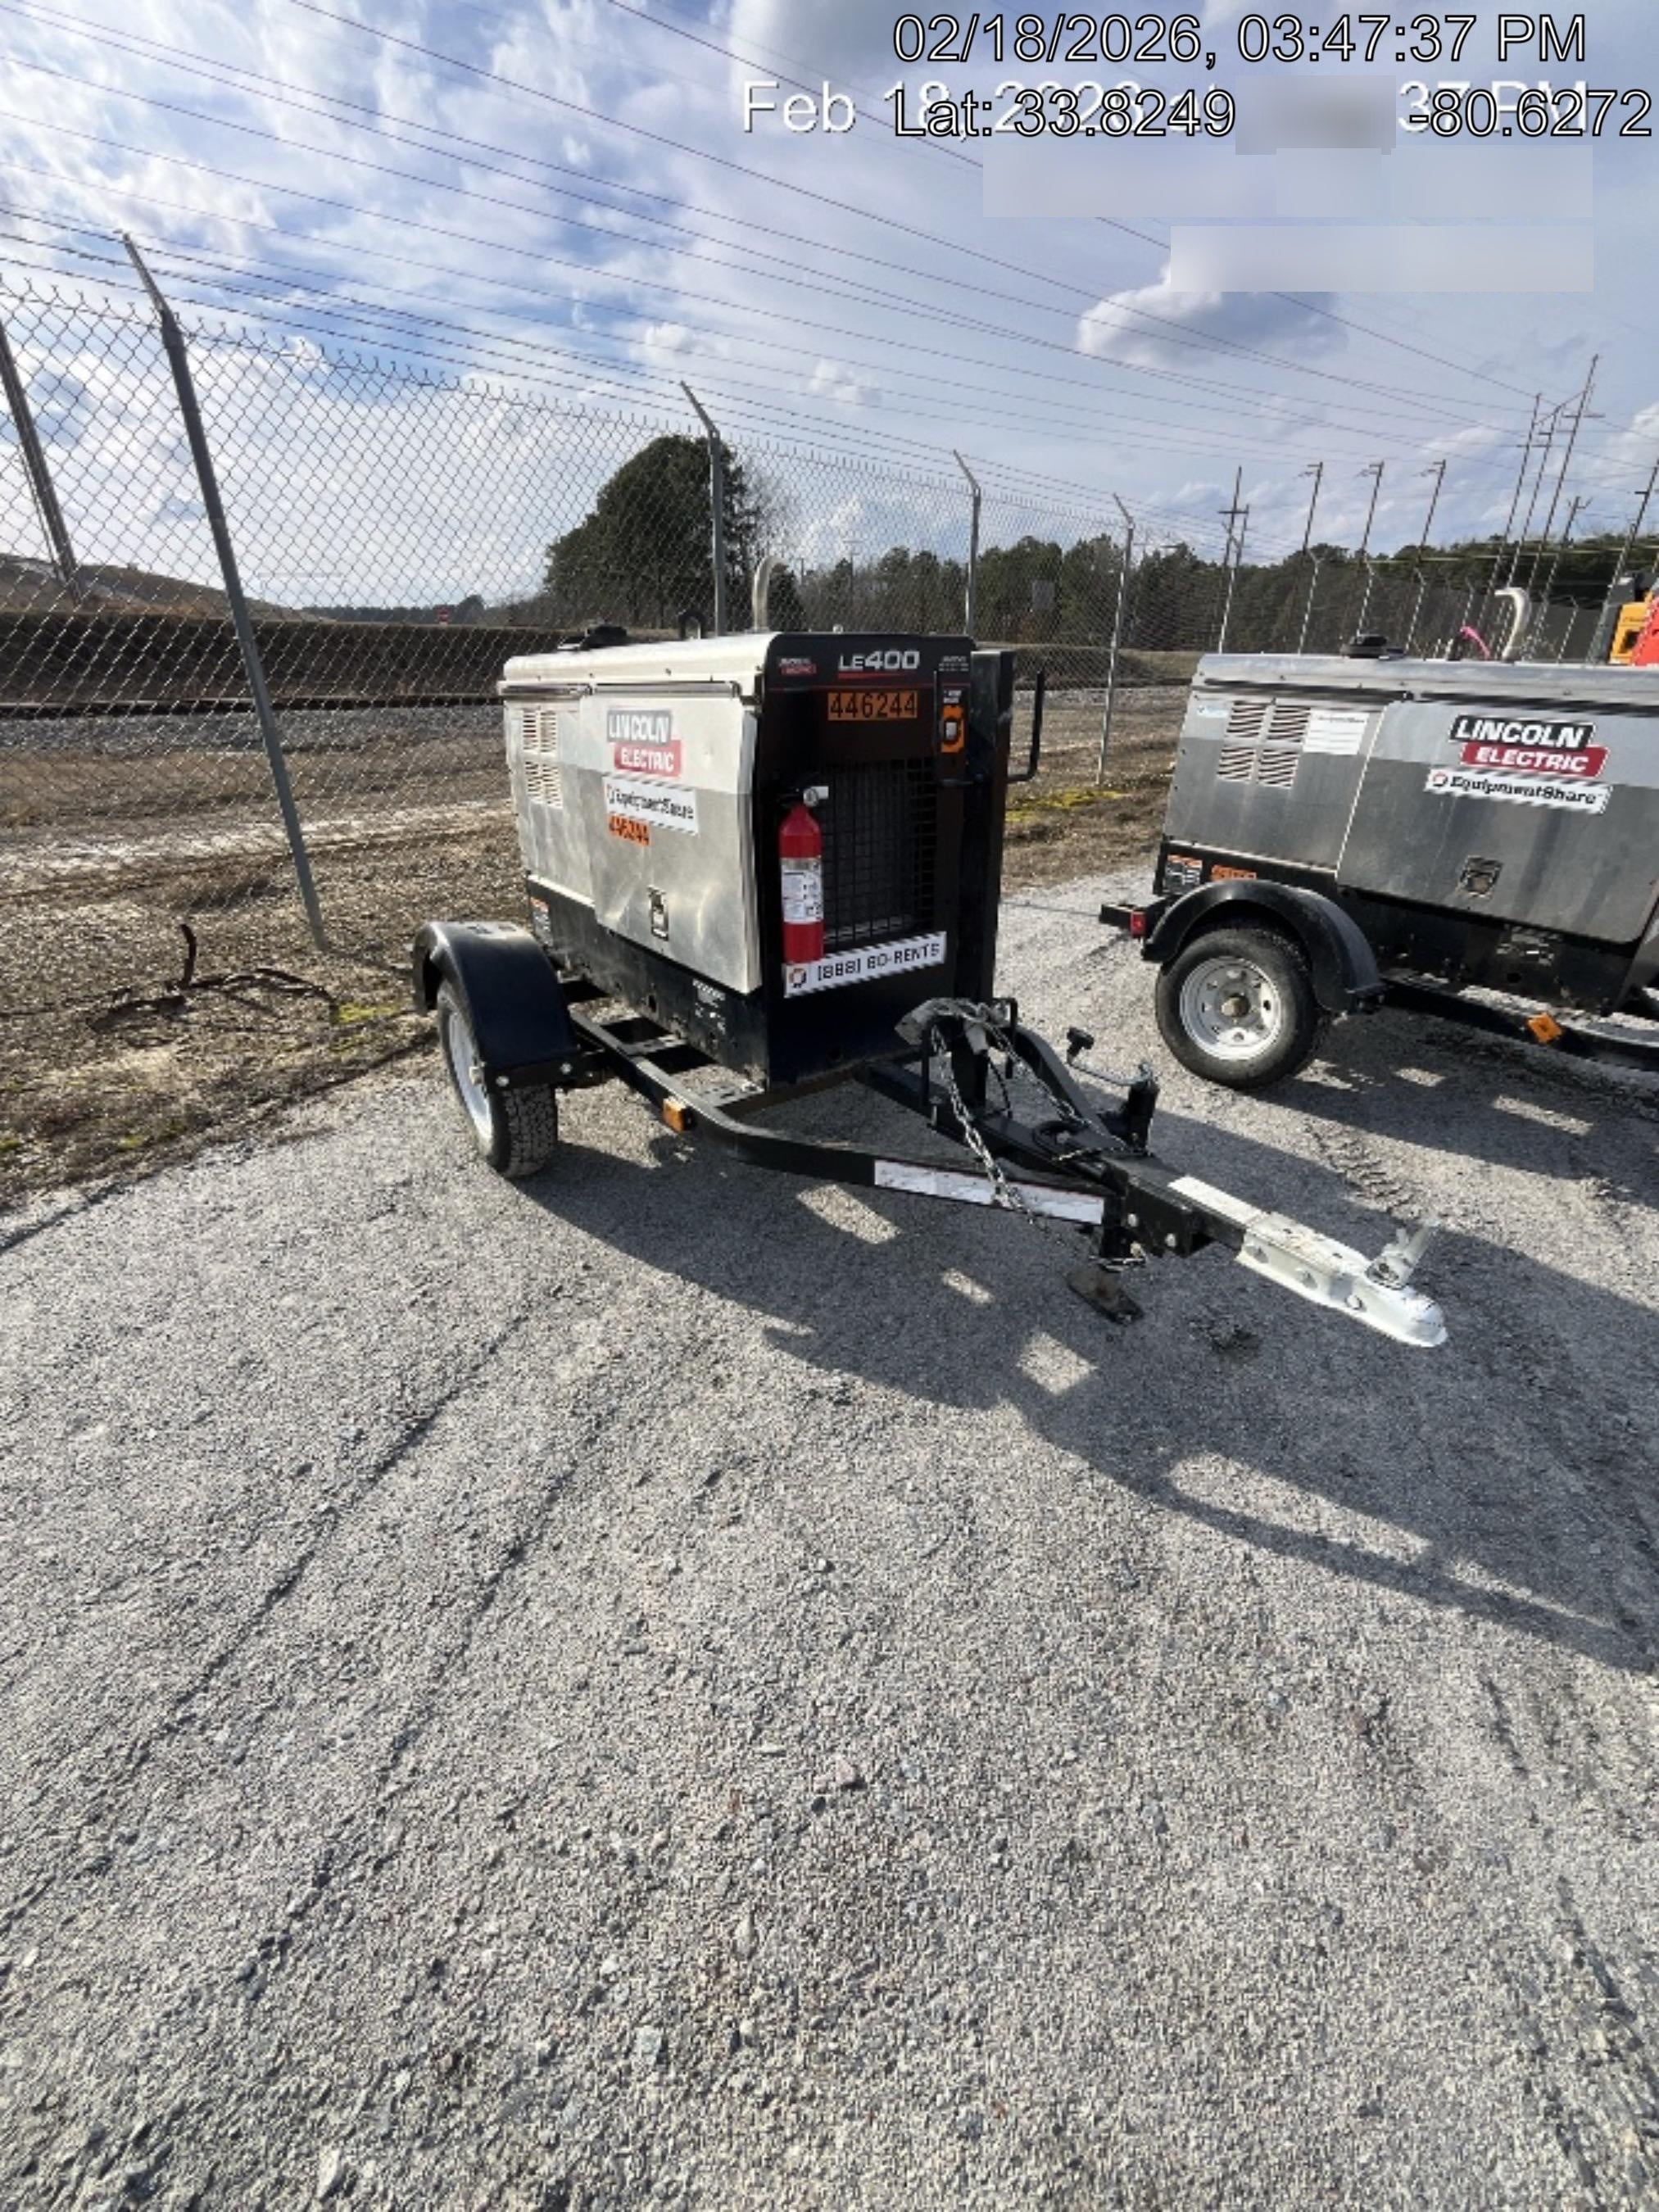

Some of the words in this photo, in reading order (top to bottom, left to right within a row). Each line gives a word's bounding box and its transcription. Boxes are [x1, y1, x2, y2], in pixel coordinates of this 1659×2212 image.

[838, 650, 920, 671] LE400
[829, 692, 917, 719] 446244
[609, 714, 669, 743] LINCOLN
[1455, 718, 1584, 749] LINCOLN
[1475, 746, 1589, 773] ELECTRIC
[1449, 775, 1597, 805] EquipmentShare
